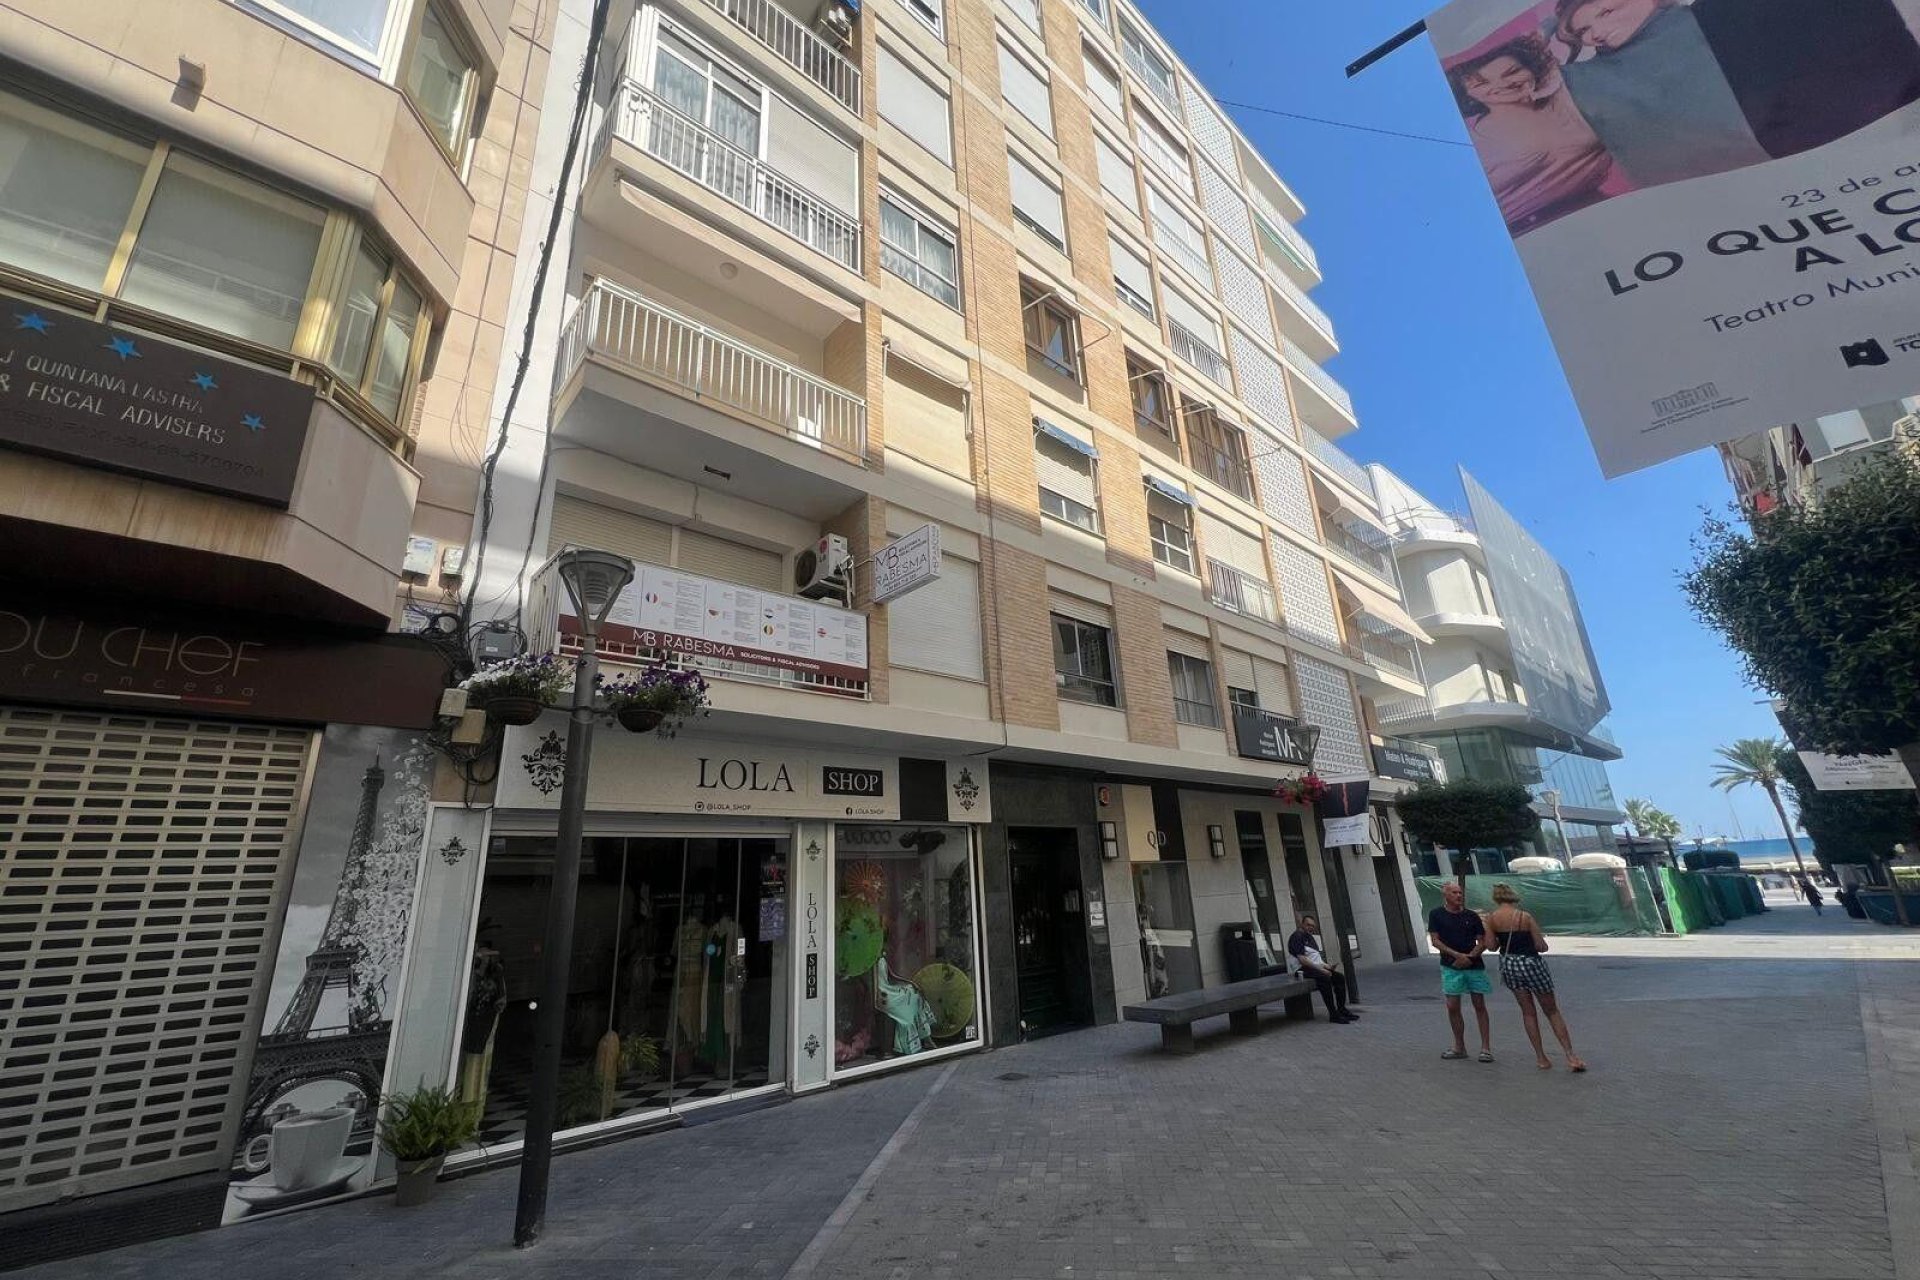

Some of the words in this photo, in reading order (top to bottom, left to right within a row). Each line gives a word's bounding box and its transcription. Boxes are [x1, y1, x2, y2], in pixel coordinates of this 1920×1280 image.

[1780, 188, 1826, 209] 23
[1839, 177, 1882, 194] de
[1894, 160, 1920, 177] a
[1604, 250, 1684, 296] LO
[1706, 208, 1855, 256] QUE
[1795, 246, 1846, 272] A
[1703, 293, 1815, 333] Teatro
[28, 381, 107, 417] FISCAL
[663, 633, 736, 658] RABESMA
[697, 758, 795, 792] LOLA
[828, 771, 879, 792] SHOP
